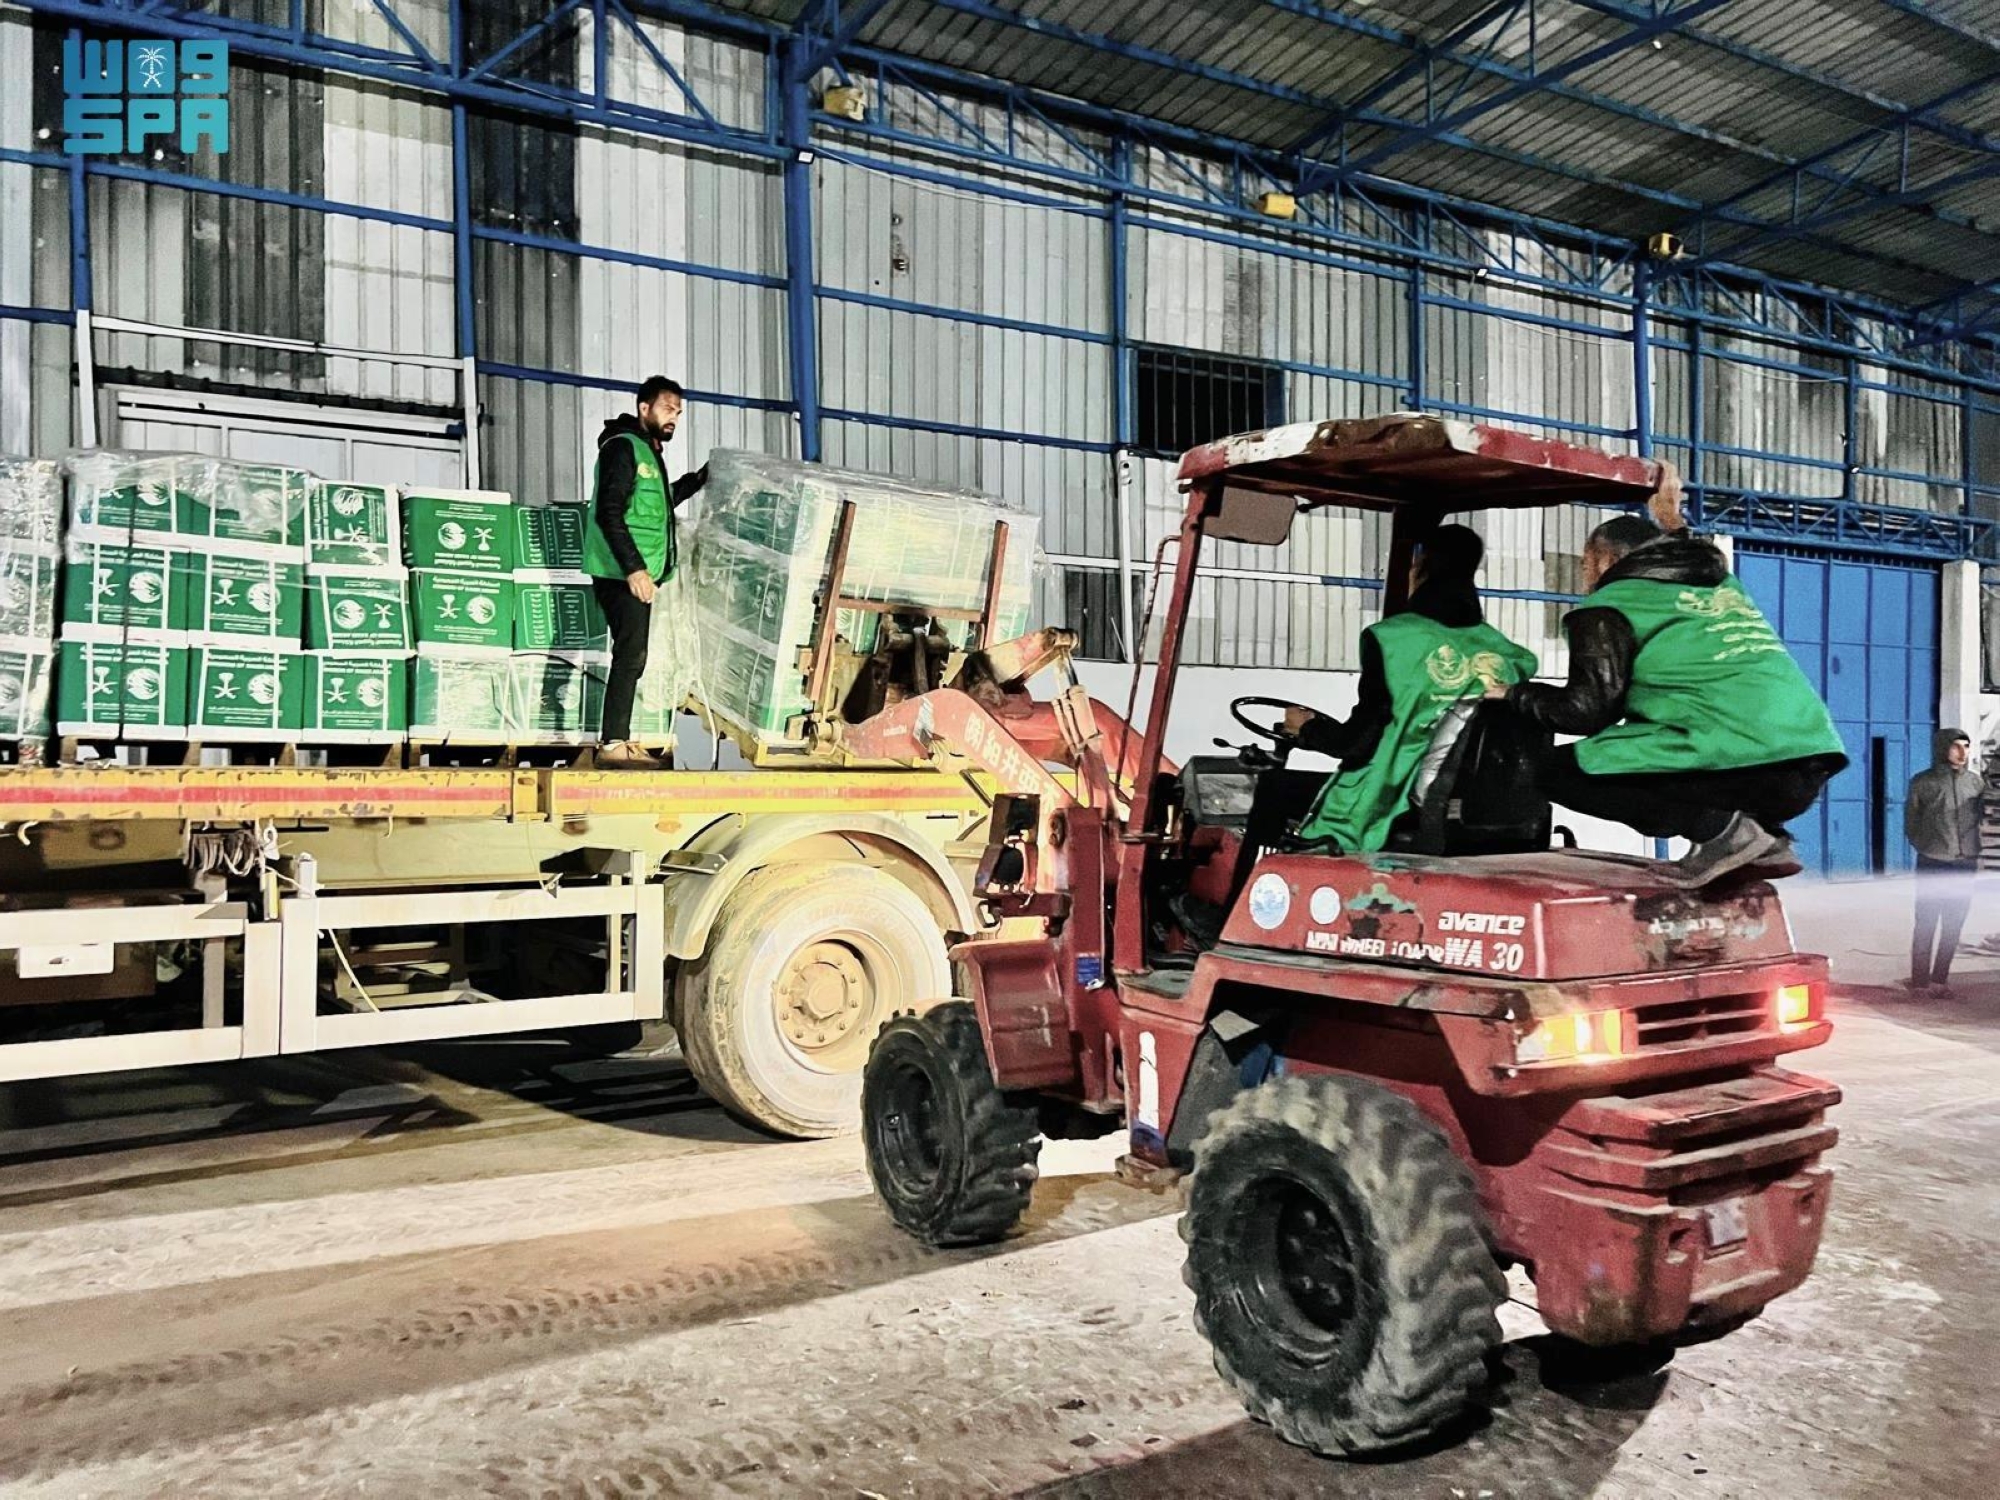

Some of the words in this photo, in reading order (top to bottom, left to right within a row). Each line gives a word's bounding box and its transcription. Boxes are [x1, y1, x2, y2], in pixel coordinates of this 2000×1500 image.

[1437, 911, 1526, 936] avance
[1443, 937, 1483, 969] WA
[1489, 941, 1525, 973] 30
